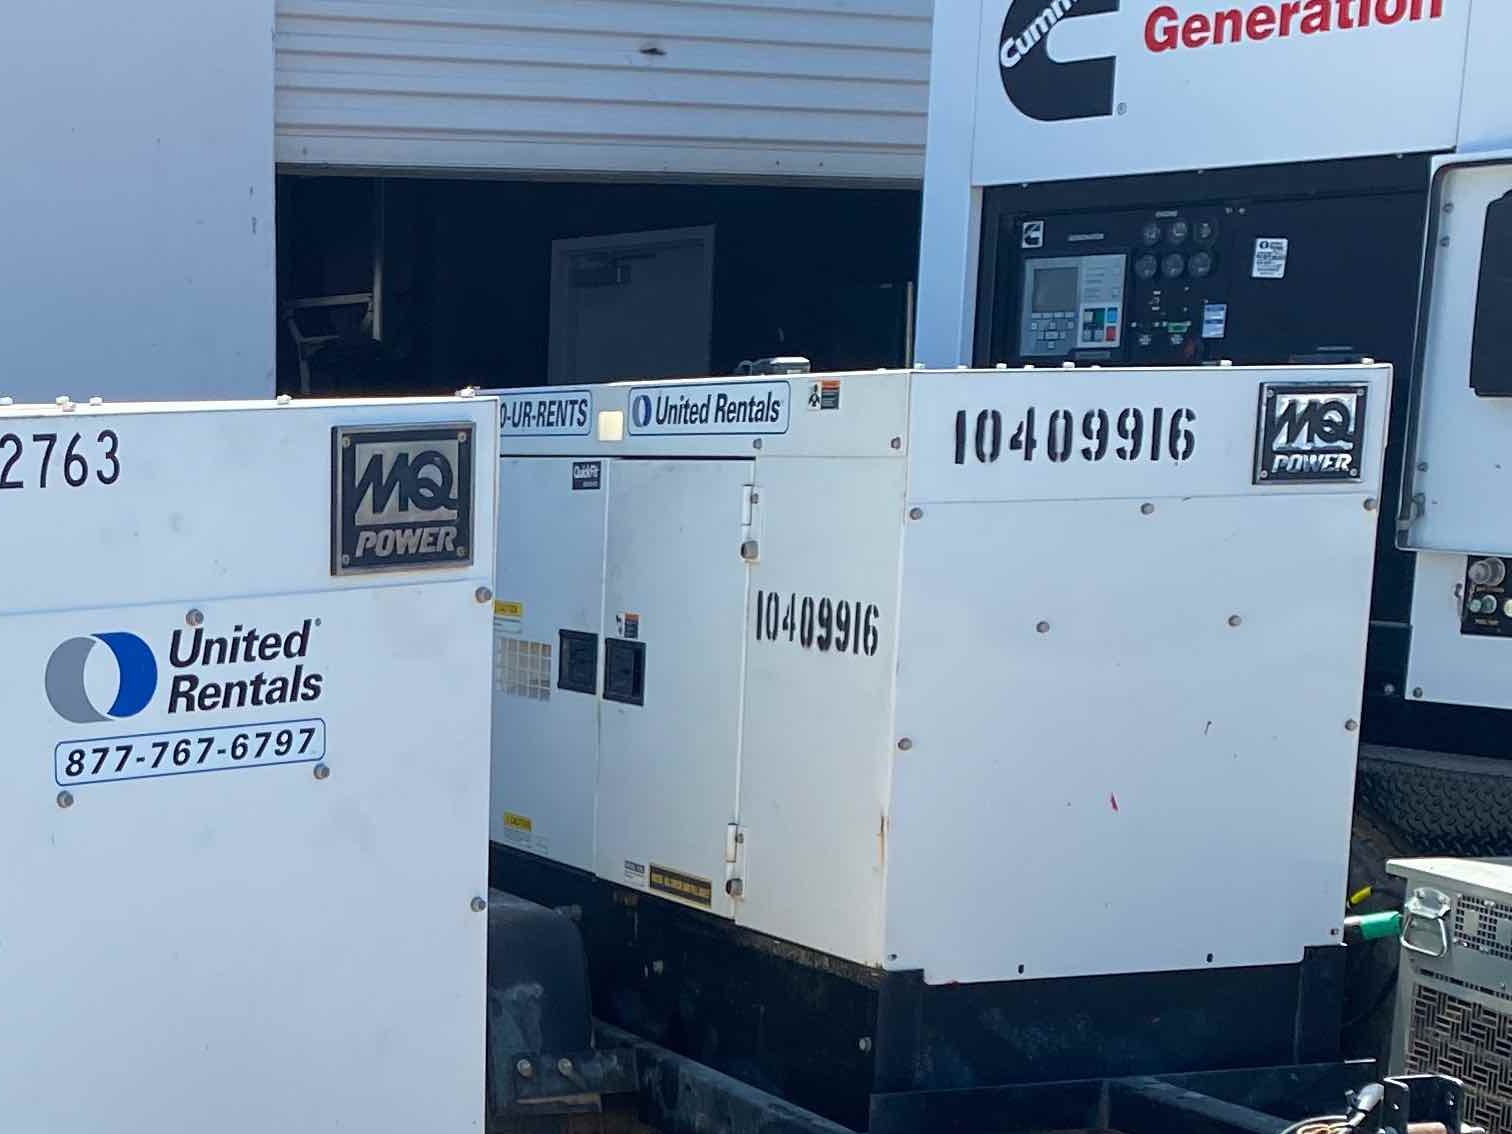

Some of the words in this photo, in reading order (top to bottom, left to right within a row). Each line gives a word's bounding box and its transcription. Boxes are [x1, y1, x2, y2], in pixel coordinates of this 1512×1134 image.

[655, 394, 712, 425] United
[714, 391, 781, 424] Rentals
[1273, 398, 1355, 446] MQ
[954, 406, 1197, 465] 10409916
[355, 449, 459, 514] MQ
[1271, 453, 1353, 474] POWER
[355, 526, 458, 558] POWER
[169, 618, 313, 668] United
[755, 589, 881, 657] 10409916
[167, 663, 324, 714] Rentals
[64, 727, 317, 778] 877-767-6797
